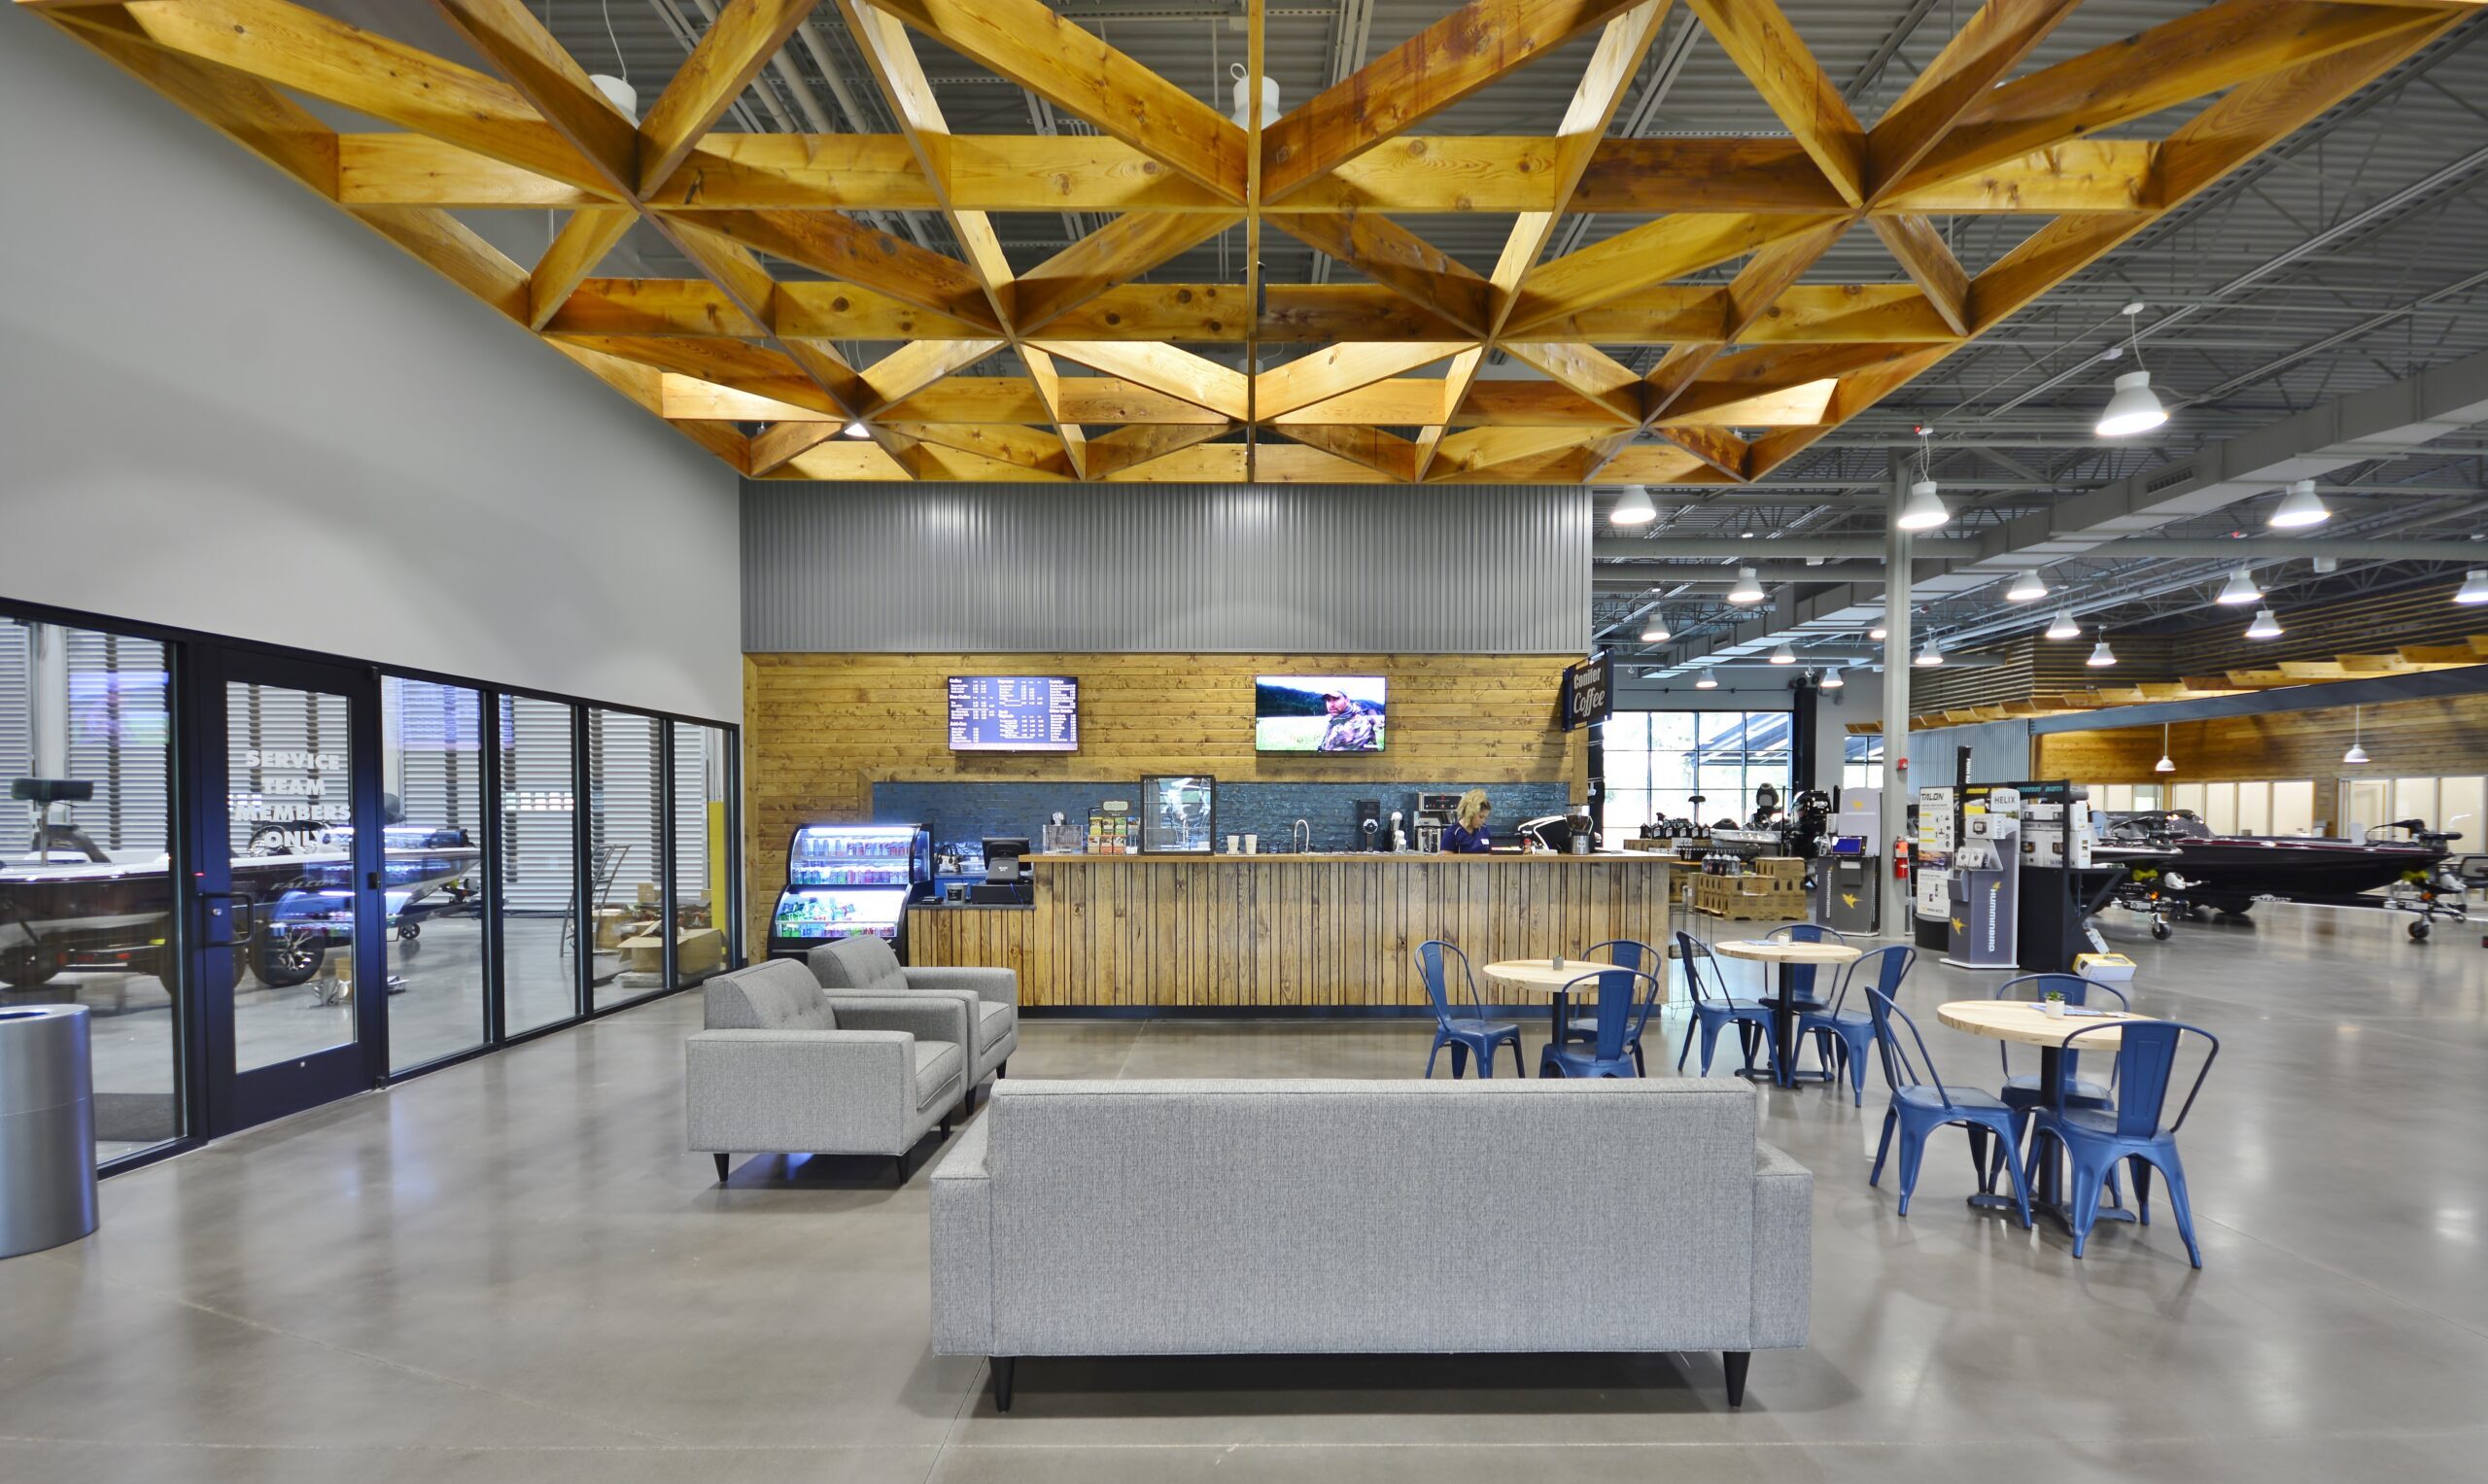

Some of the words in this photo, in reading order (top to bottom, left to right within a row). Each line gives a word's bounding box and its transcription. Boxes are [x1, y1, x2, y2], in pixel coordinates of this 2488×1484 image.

[1574, 668, 1601, 689] Conifer
[1573, 687, 1605, 717] Coffee
[245, 750, 339, 770] SERVICE
[262, 778, 327, 796] TEAM
[1920, 792, 1945, 802] TALON
[1993, 796, 2016, 805] HELIX
[233, 805, 351, 822] MEMBERS
[263, 829, 328, 848] ONLY
[269, 878, 341, 891] FALCON
[1988, 888, 1997, 952] HUMMINBIRD
